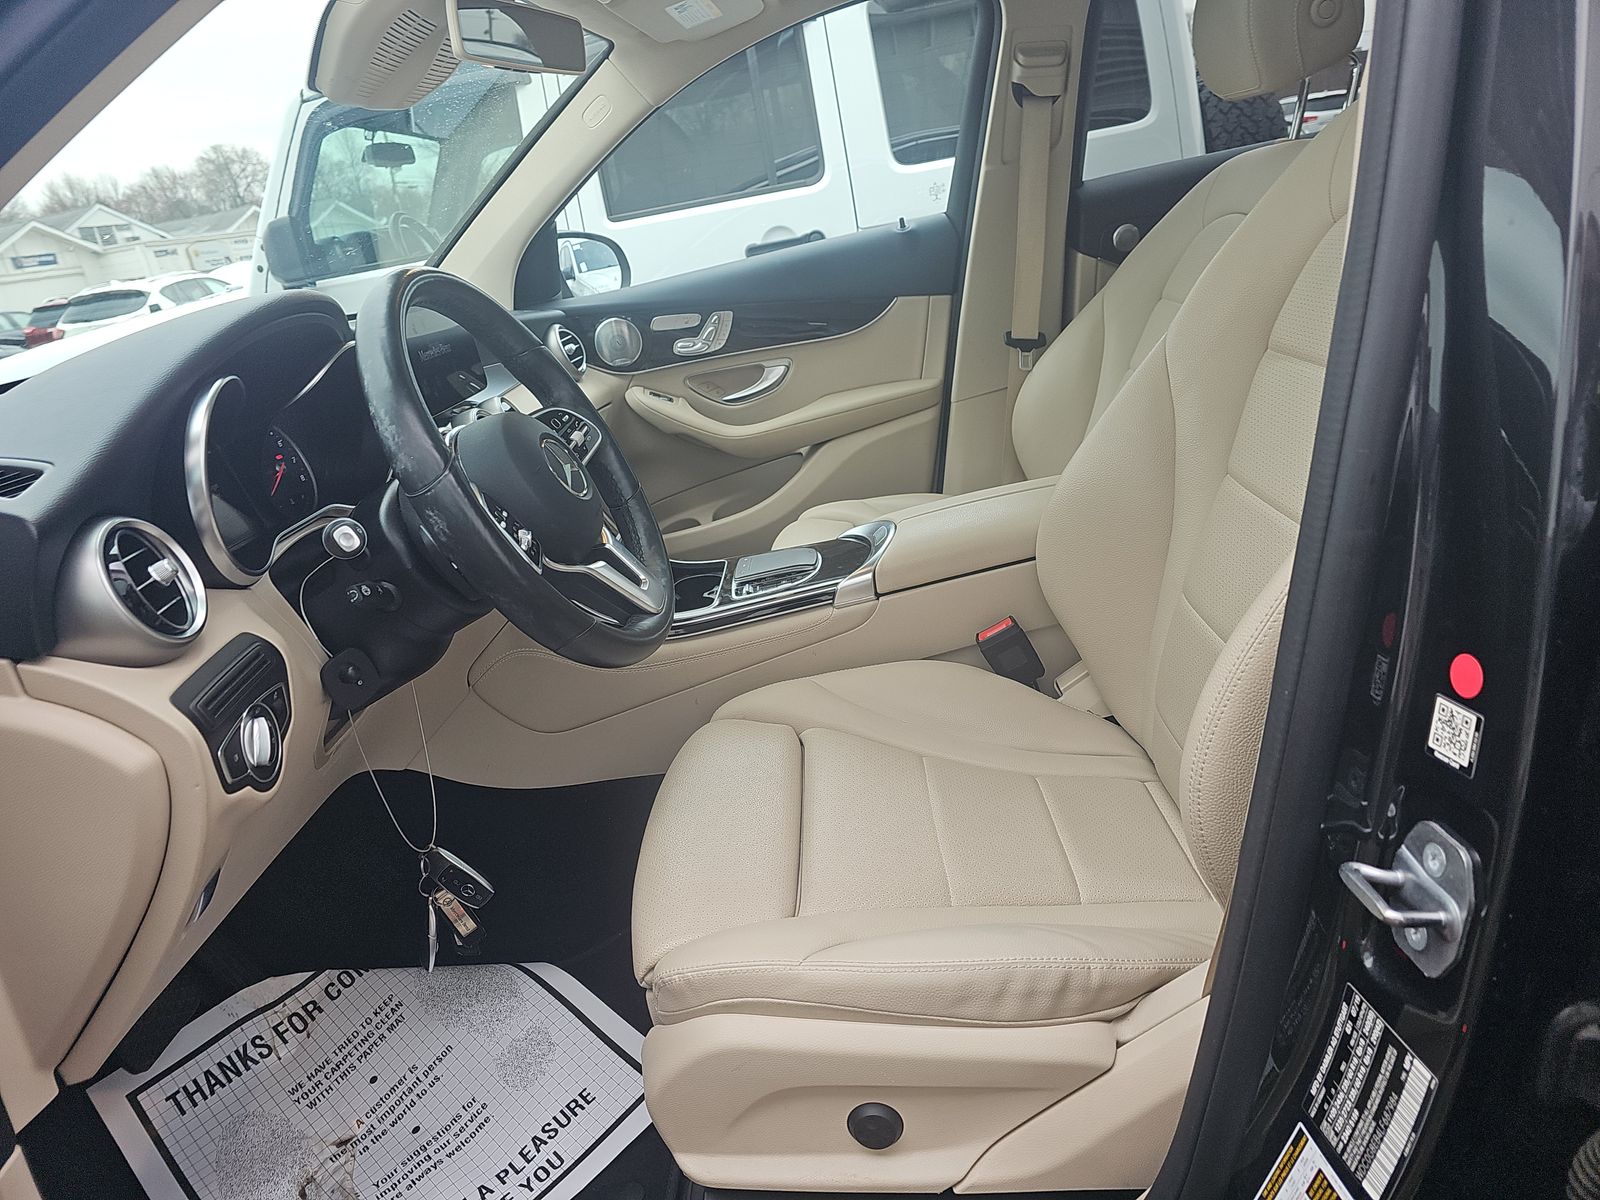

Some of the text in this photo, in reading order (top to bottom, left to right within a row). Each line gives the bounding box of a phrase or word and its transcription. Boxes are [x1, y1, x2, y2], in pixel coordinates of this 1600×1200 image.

[165, 1034, 273, 1117] THANKS
[272, 1000, 324, 1045] FOR
[288, 994, 395, 1096] WE HAVE TRIED TO KEEP
[294, 1000, 404, 1105] YOUR CARPETING CLEAN
[306, 1013, 407, 1110] WITH THIS PAPER MAT
[1310, 1079, 1320, 1096] MFD
[1316, 1071, 1323, 1082] BY
[1330, 1036, 1337, 1048] AG
[1334, 1002, 1348, 1038] STUTTGART
[329, 1044, 454, 1163] the most important person
[355, 1063, 419, 1129] A customer is
[358, 1074, 444, 1156] in the world to us.
[372, 1096, 477, 1188] Your suggestions for
[477, 1087, 597, 1200] A PLEASURE
[375, 1102, 489, 1200] improving our service
[406, 1158, 444, 1192] always
[445, 1114, 495, 1160] welcome.
[518, 1150, 565, 1193] YOU
